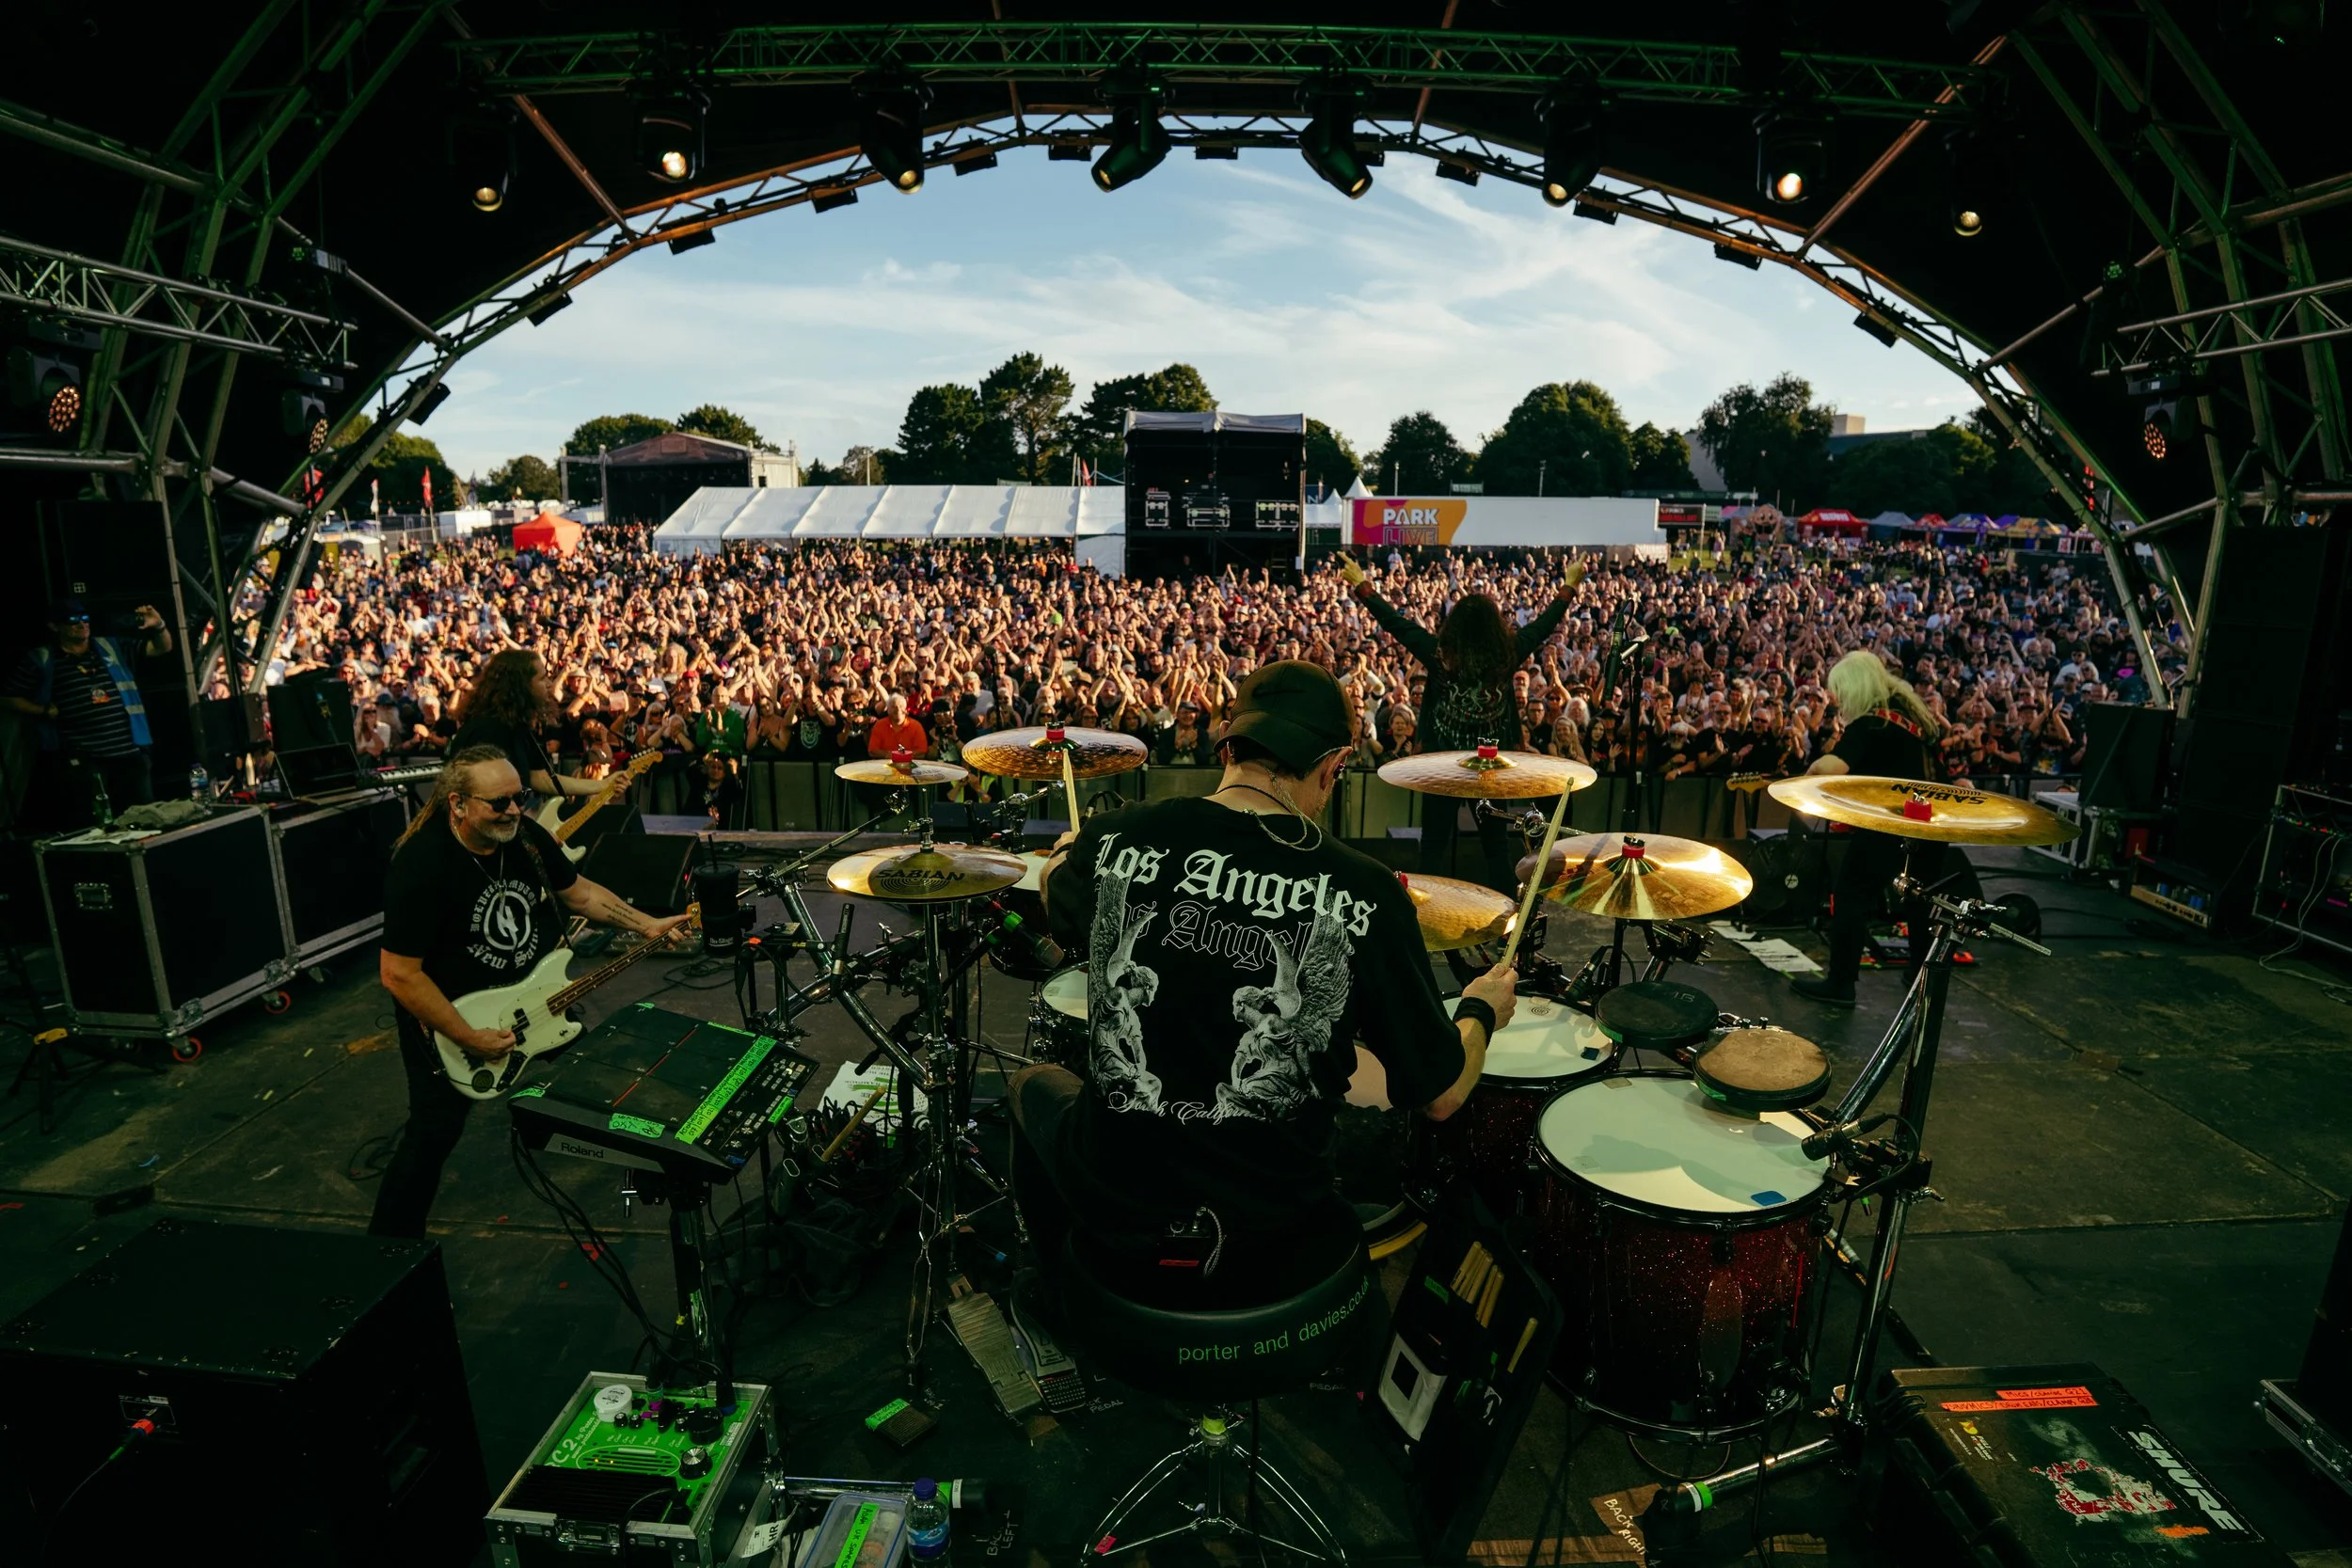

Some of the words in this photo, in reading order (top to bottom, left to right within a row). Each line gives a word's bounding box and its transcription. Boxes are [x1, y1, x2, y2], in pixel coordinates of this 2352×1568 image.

[1383, 509, 1438, 525] PARK
[1383, 527, 1438, 546] LIVE
[1891, 784, 1988, 805] SABIAN
[875, 869, 965, 881] SABIAN
[1093, 832, 1170, 885] Los
[1173, 848, 1377, 937] Angeles
[1107, 1091, 1169, 1117] Souh
[561, 1142, 605, 1159] Roland
[1178, 1343, 1241, 1364] porter
[1253, 1331, 1289, 1355] and
[1089, 1398, 1124, 1414] PEDAL
[2126, 1431, 2246, 1531] SHURE
[1603, 1497, 1634, 1528] BACK
[1001, 1521, 1018, 1549] LEFT
[1618, 1528, 1648, 1556] RIGH
